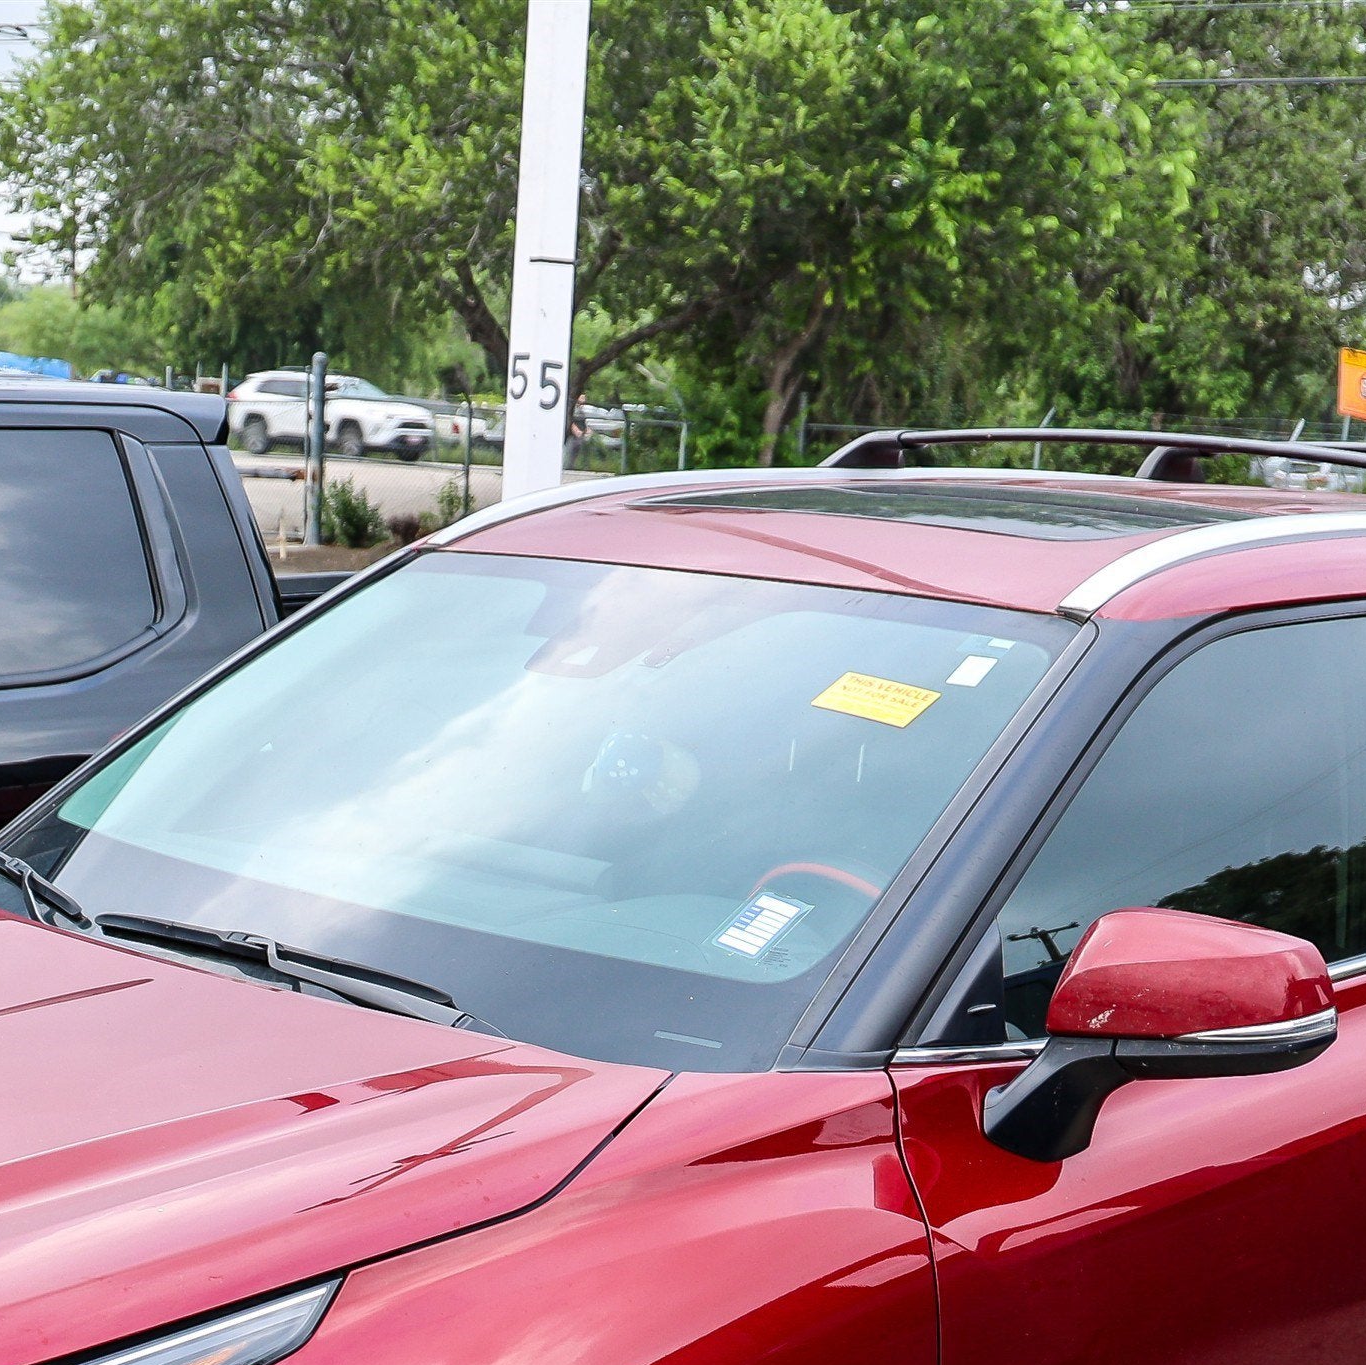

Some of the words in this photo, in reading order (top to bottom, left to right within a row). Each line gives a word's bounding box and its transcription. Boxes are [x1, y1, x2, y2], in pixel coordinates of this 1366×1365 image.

[509, 352, 564, 410] 55
[848, 675, 874, 688] THIS
[877, 682, 934, 703] VEHICLE
[890, 697, 921, 709] SALE
